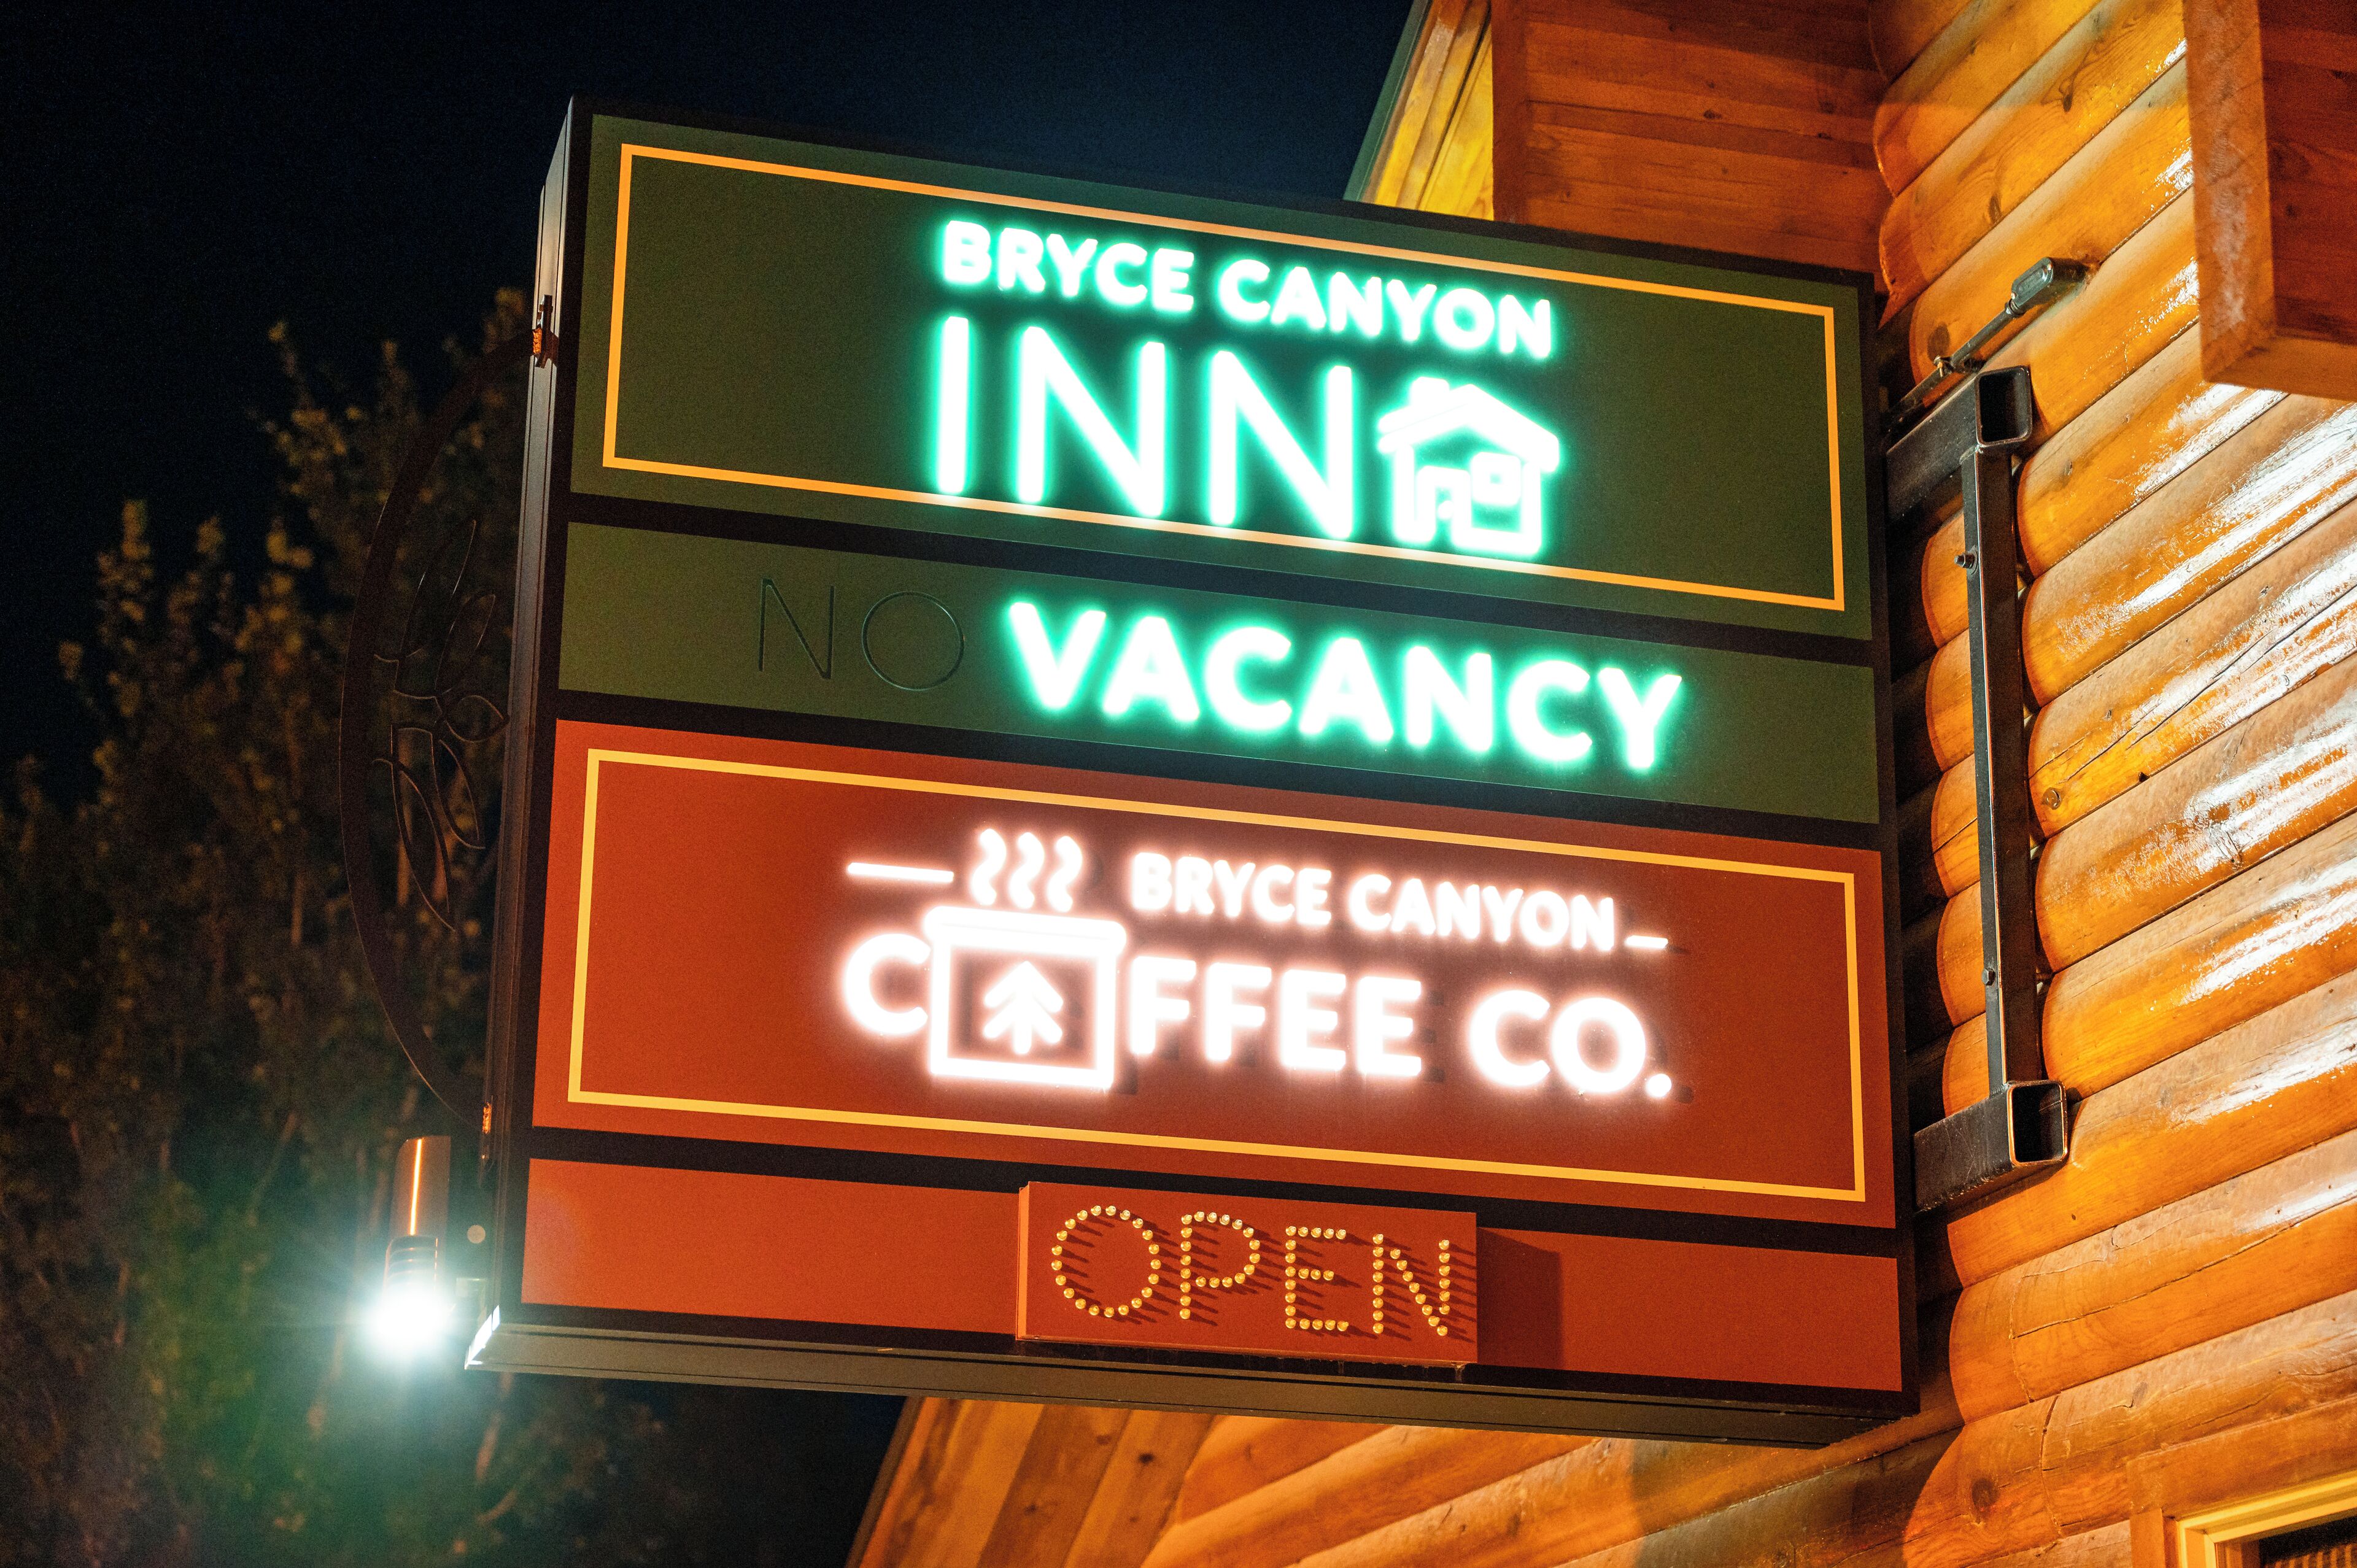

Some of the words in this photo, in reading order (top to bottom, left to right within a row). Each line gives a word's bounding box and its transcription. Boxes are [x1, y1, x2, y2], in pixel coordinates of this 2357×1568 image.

[939, 218, 1195, 314] BRYCE
[1215, 257, 1553, 360] CANYON
[933, 314, 1354, 541] INN
[757, 577, 965, 692] NO
[1005, 599, 1684, 771] VACANCY
[1128, 851, 1332, 928] BRYCE
[1349, 873, 1616, 951] CANYON
[1466, 989, 1673, 1099] CO.
[1051, 1204, 1452, 1337] OPEN
